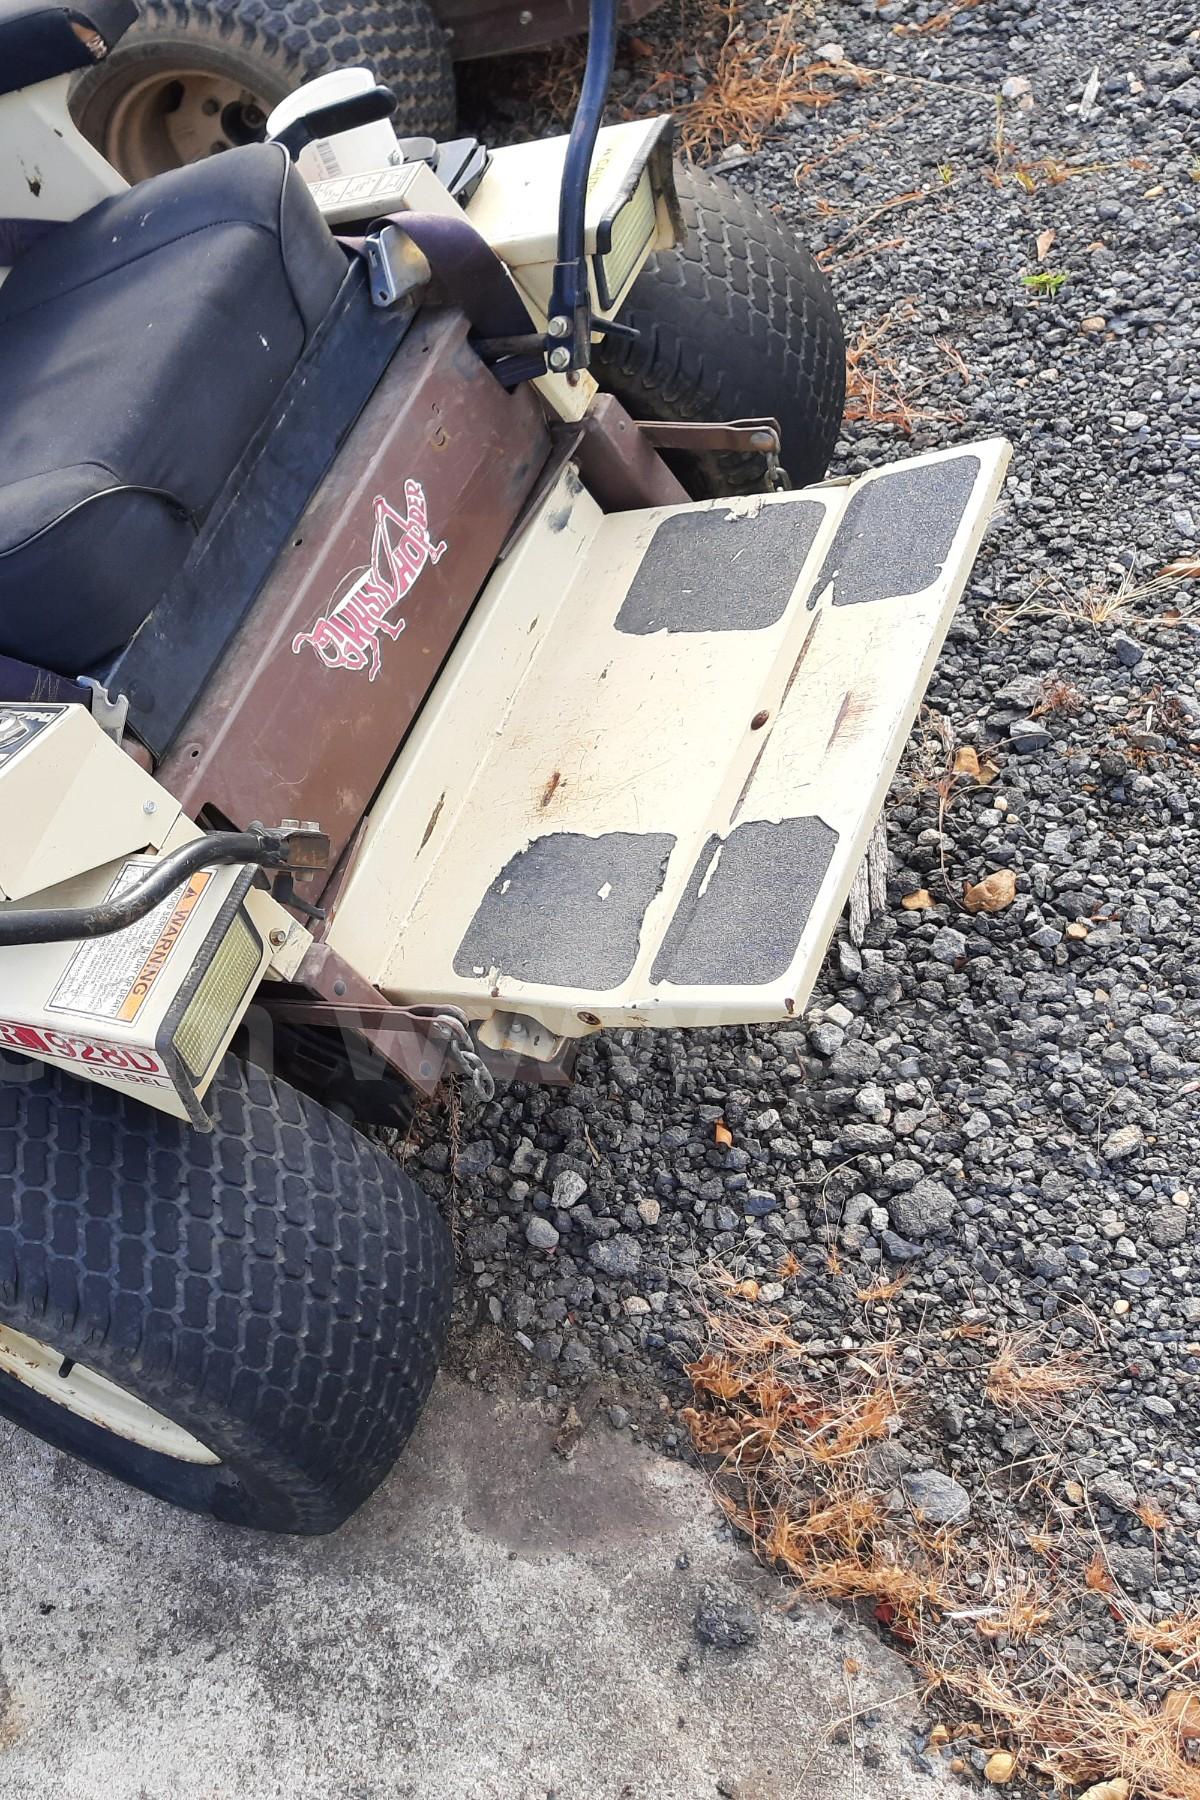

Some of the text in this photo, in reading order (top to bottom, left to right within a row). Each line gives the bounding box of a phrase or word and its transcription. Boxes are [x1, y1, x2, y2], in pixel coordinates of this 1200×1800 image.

[145, 910, 171, 945] SERIOUS
[132, 909, 188, 997] WARNING
[109, 988, 130, 1015] DEATH
[89, 1066, 169, 1090] DIESEL
